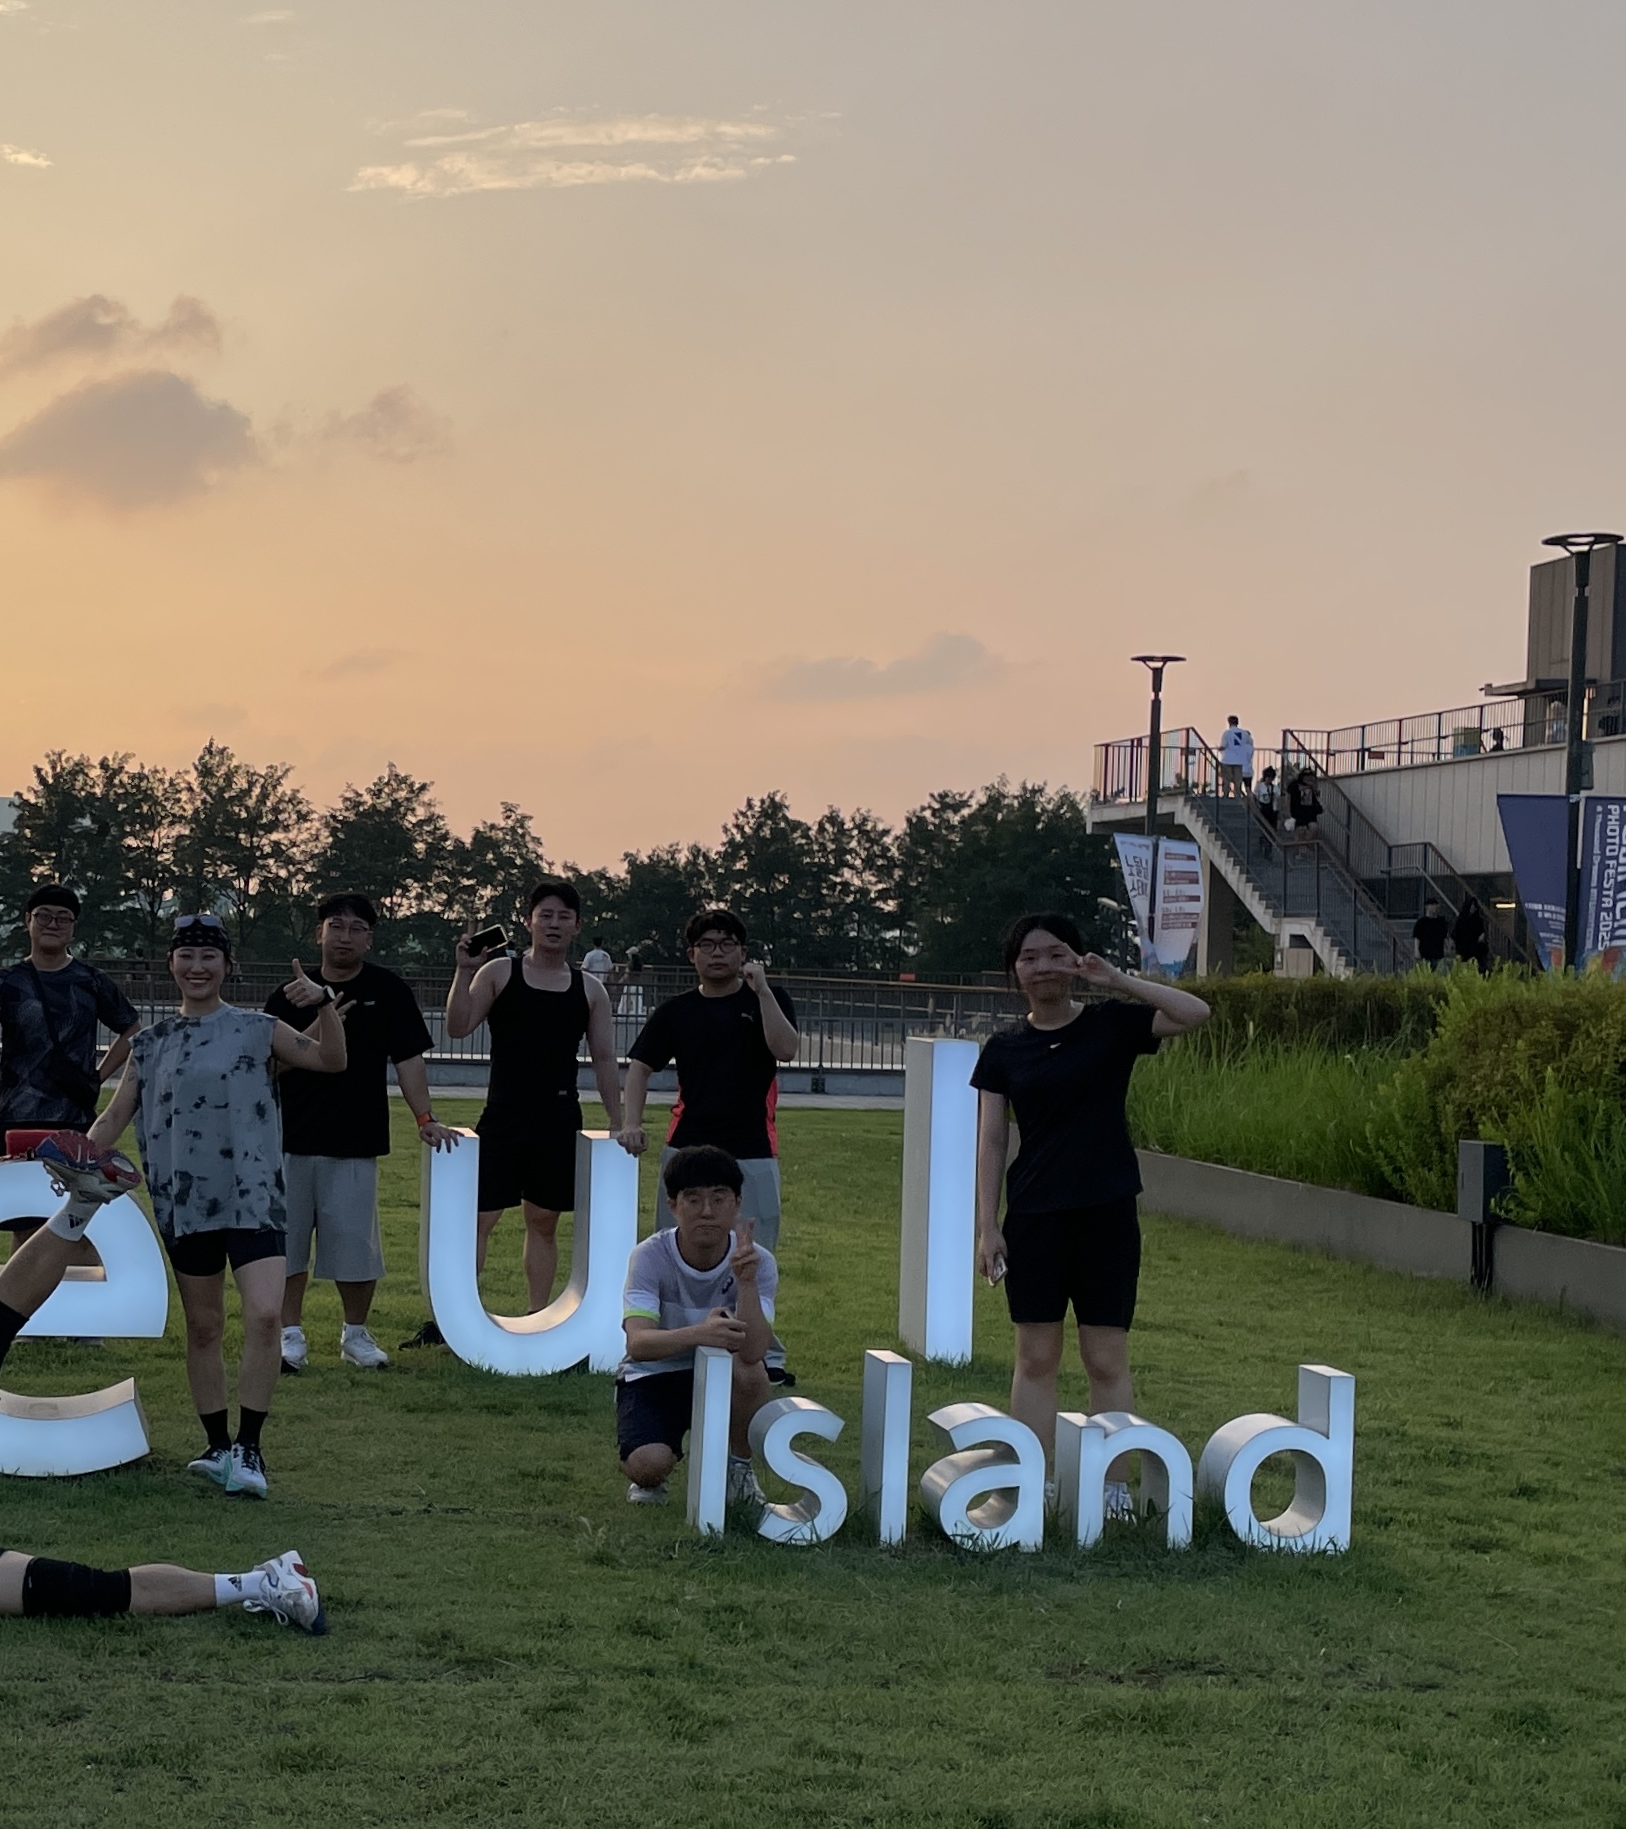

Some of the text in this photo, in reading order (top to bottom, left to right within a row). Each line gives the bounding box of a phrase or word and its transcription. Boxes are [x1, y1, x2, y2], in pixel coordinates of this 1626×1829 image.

[1605, 804, 1620, 857] PHOTO
[1601, 860, 1616, 908] FESTA
[1597, 912, 1613, 951] 2025
[688, 1347, 1356, 1553] Island
